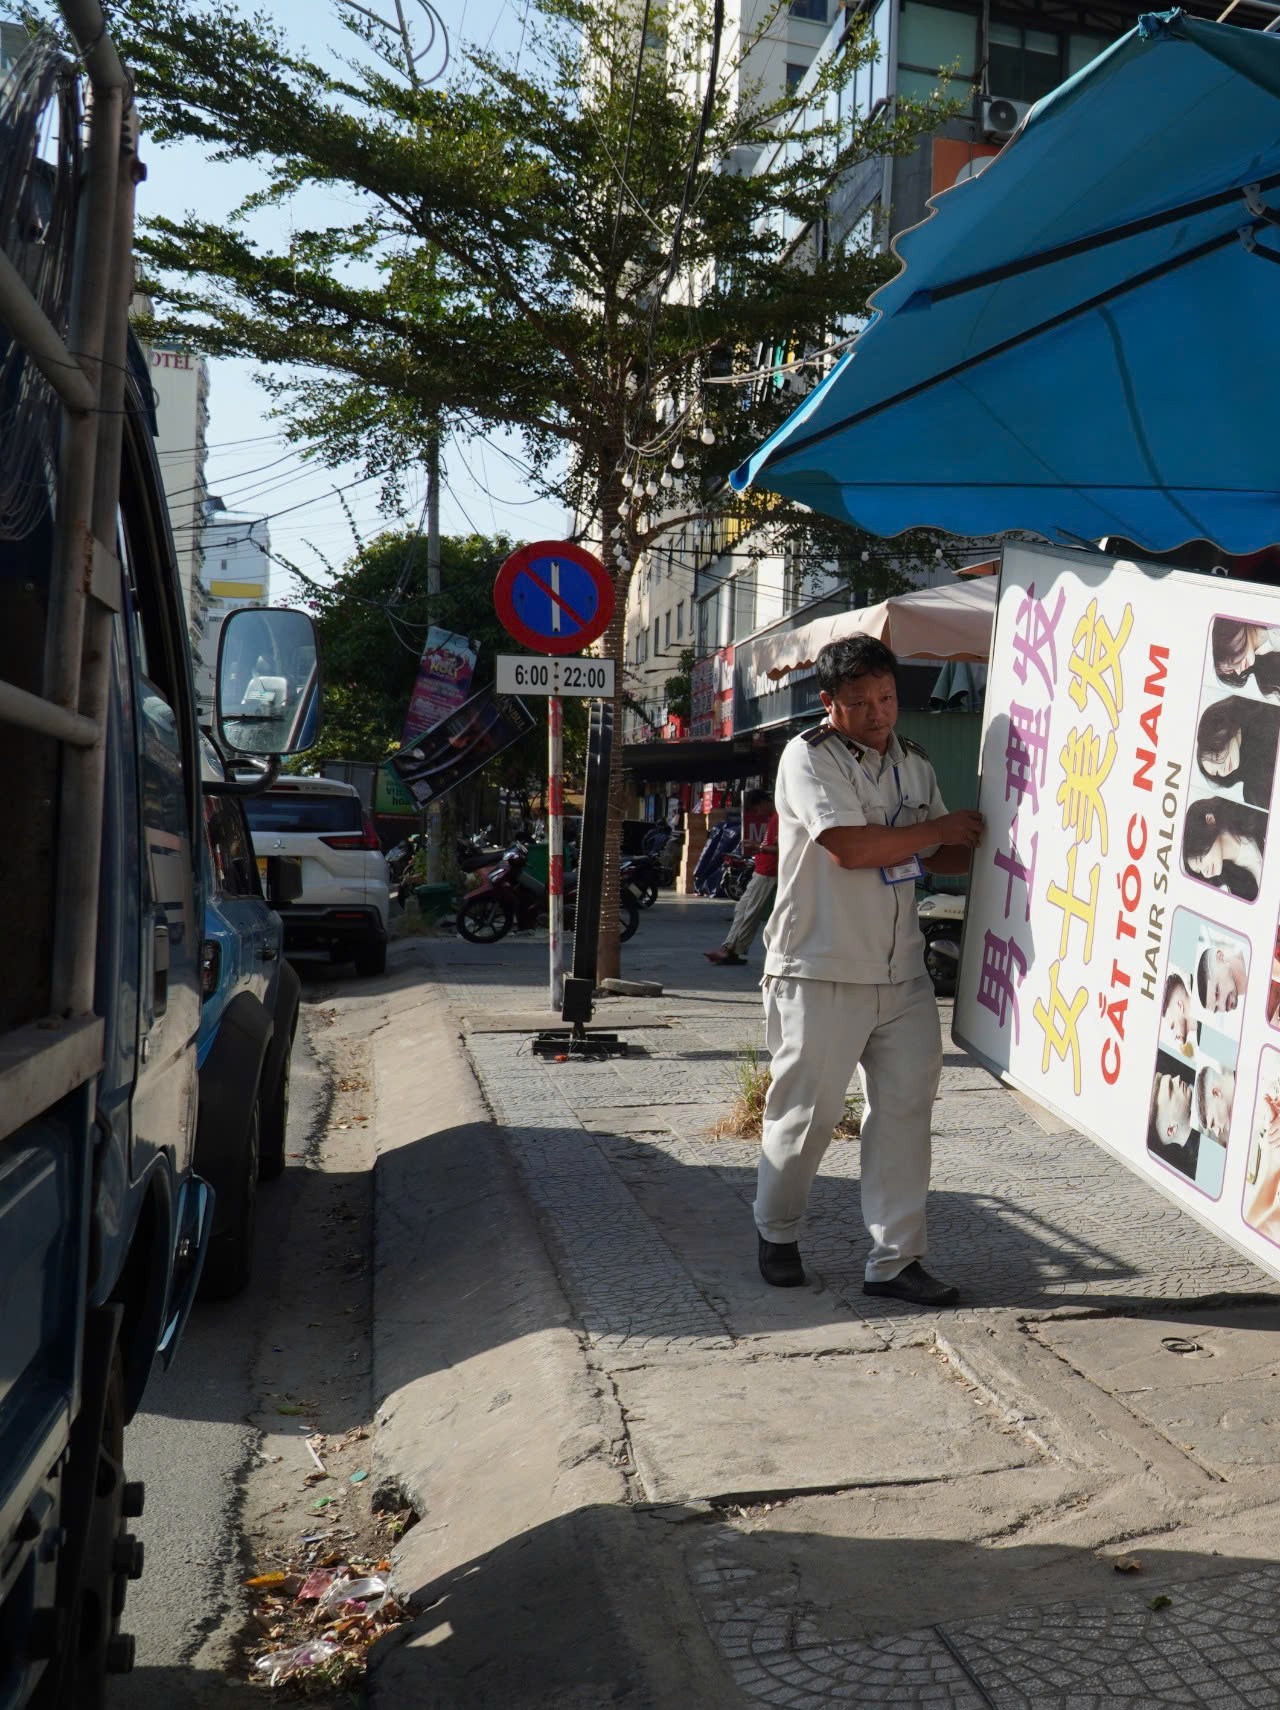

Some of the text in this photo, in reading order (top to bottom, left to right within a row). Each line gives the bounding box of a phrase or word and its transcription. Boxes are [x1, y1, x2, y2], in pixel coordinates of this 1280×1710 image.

[152, 352, 194, 370] OTEL
[515, 664, 548, 686] 6:00
[563, 666, 605, 689] 22:00
[977, 582, 1066, 1046] 男士理发
[1033, 597, 1134, 1097] 女士美发
[1098, 644, 1171, 1085] CẮT TÓC NAM
[1140, 760, 1184, 1001] HAIR SALON
